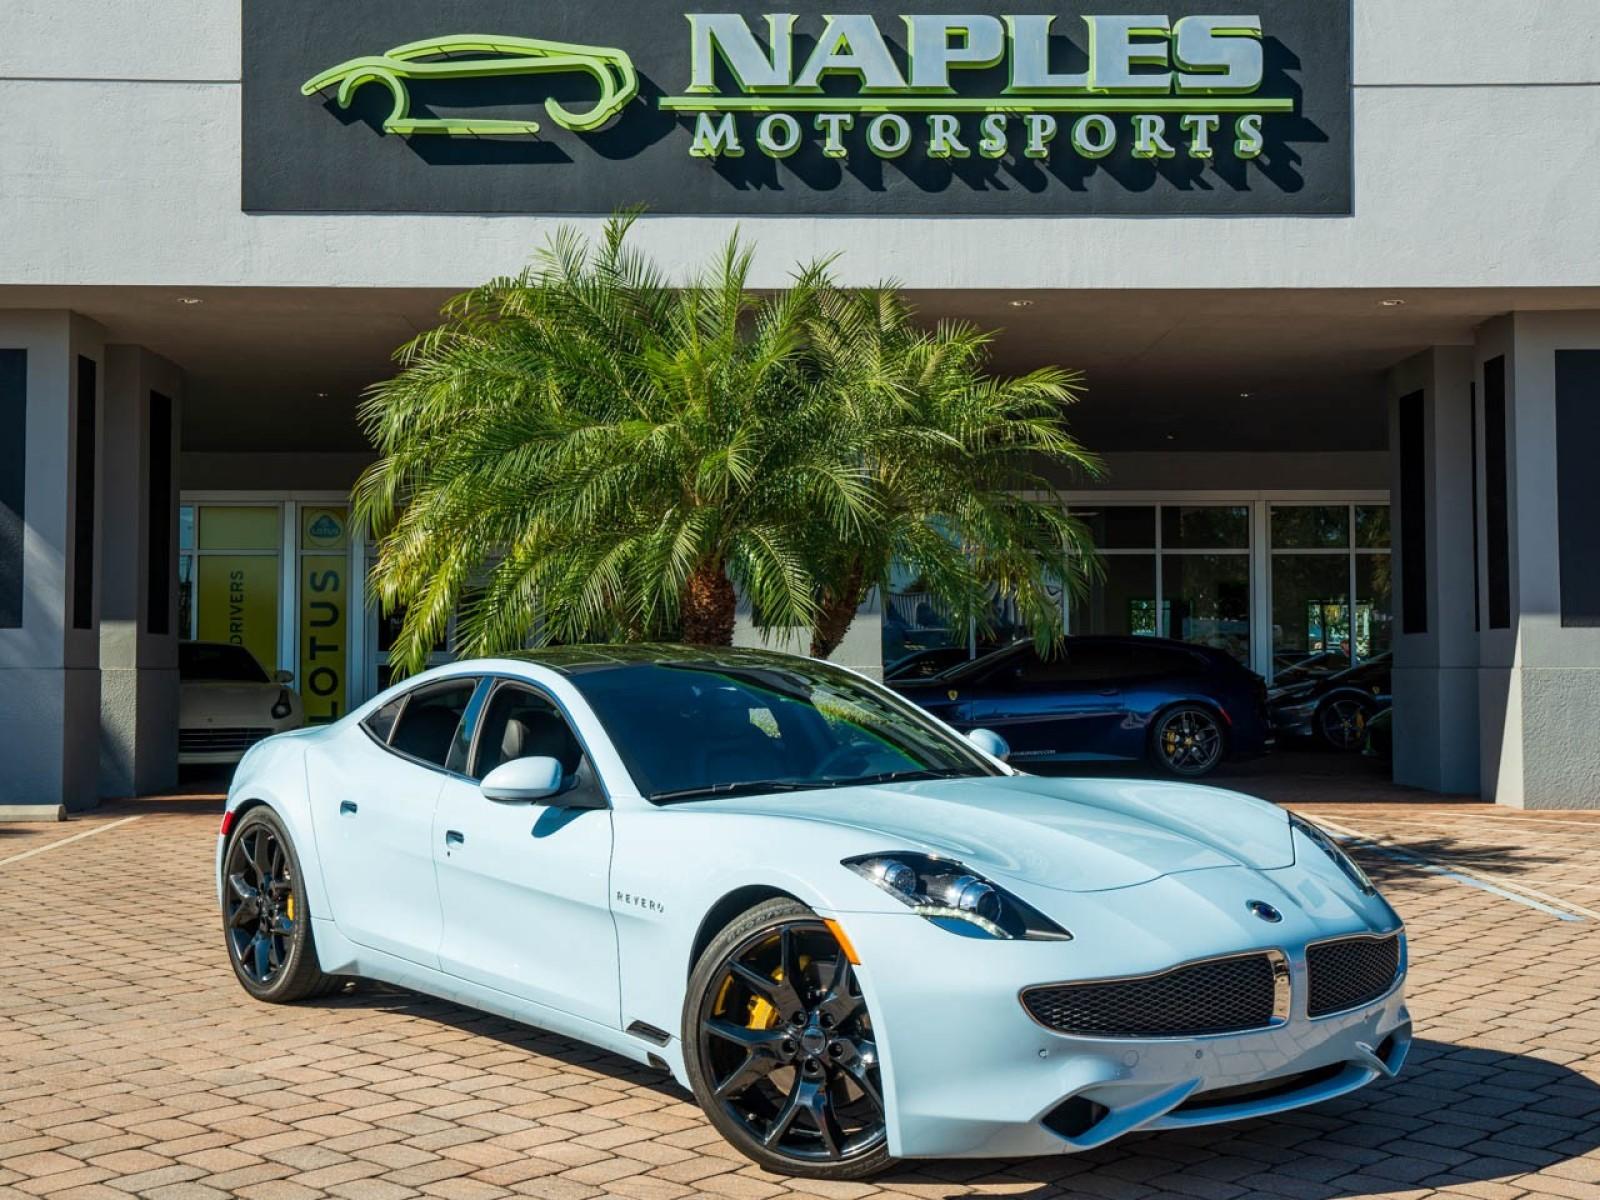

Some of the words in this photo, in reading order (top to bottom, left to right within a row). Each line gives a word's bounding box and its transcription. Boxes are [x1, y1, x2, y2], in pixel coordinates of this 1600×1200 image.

[685, 13, 1264, 94] NAPLES
[689, 112, 1264, 158] MOTORSPORTS
[230, 570, 244, 646] DRIVERS
[308, 569, 339, 722] LOTUS
[616, 891, 664, 913] REVERO
